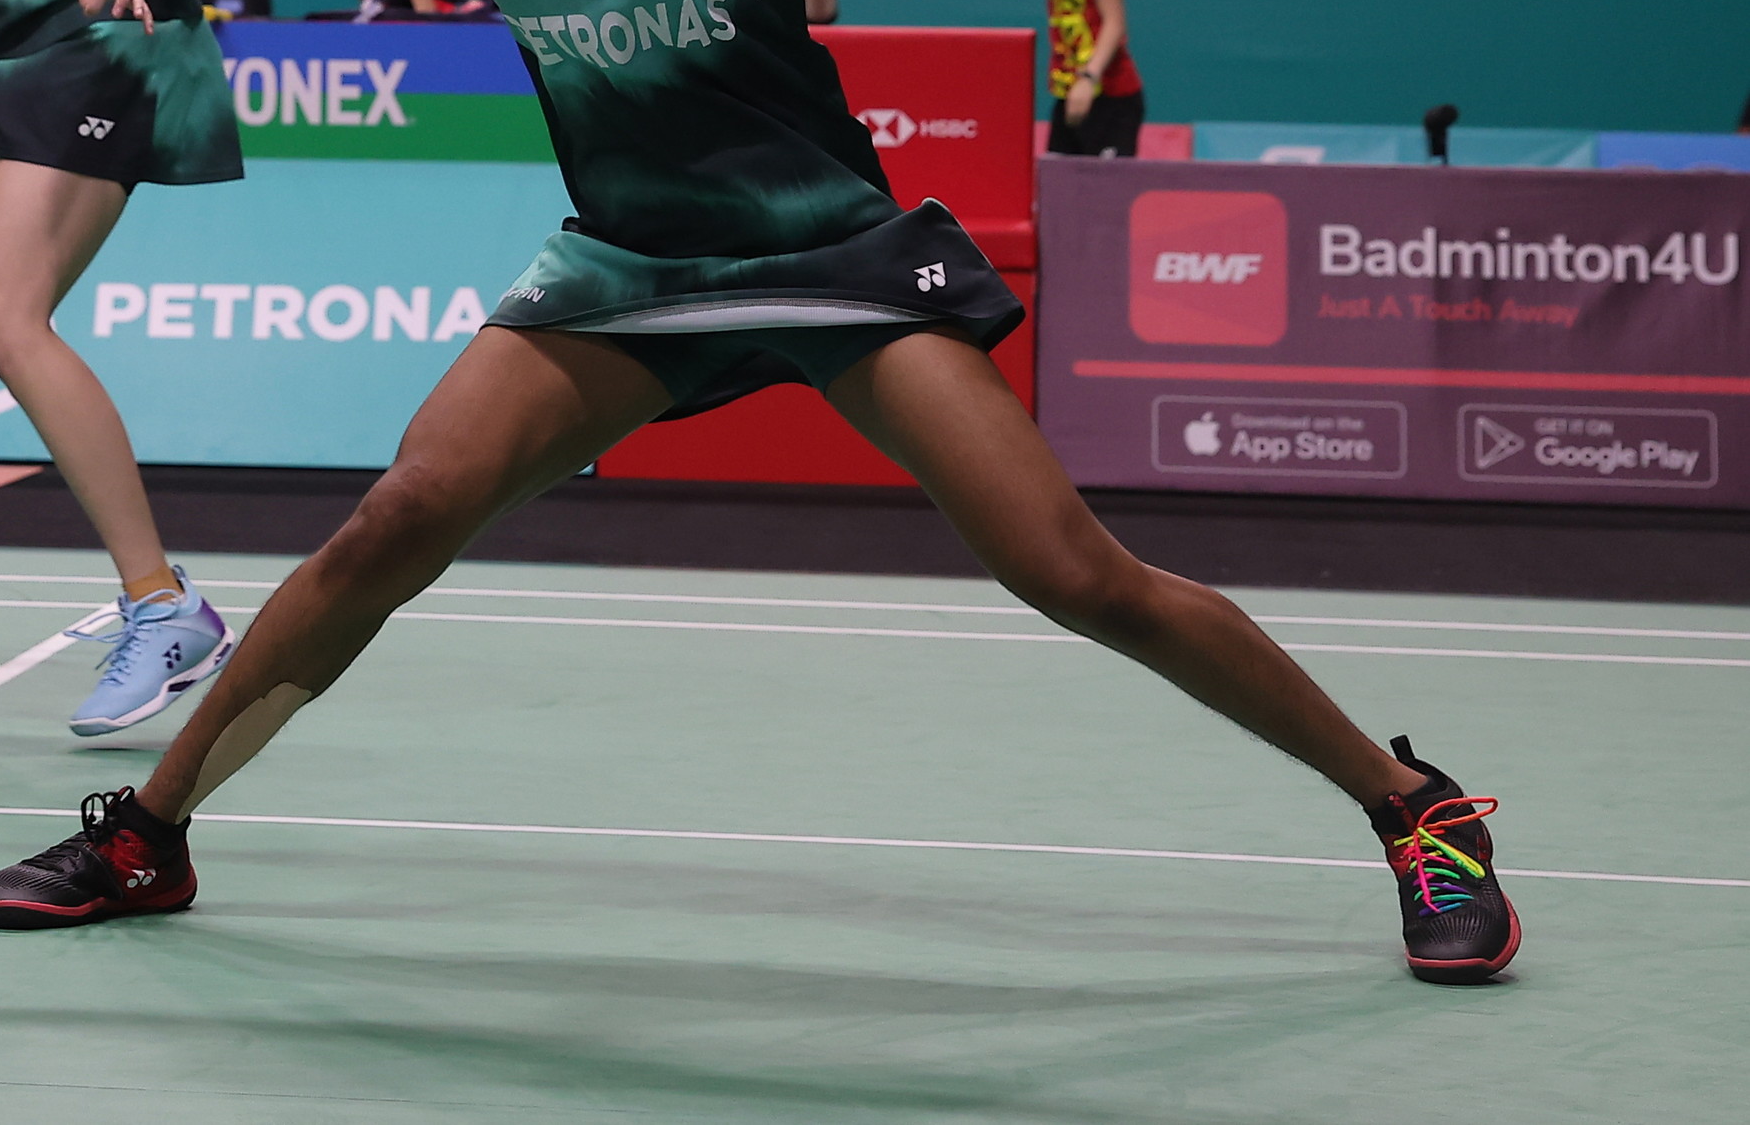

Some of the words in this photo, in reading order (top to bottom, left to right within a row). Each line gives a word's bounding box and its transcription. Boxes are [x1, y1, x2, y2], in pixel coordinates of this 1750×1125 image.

[223, 57, 409, 127] ONEX
[1153, 251, 1263, 285] BWF
[1319, 224, 1740, 285] Badminton4U
[1318, 294, 1371, 319] Just
[1377, 295, 1402, 319] A
[1412, 294, 1492, 321] Touch
[1500, 298, 1581, 329] Away
[1230, 430, 1291, 463] App
[1295, 430, 1374, 462] Store
[1534, 436, 1638, 475] Google
[1640, 440, 1699, 476] Play
